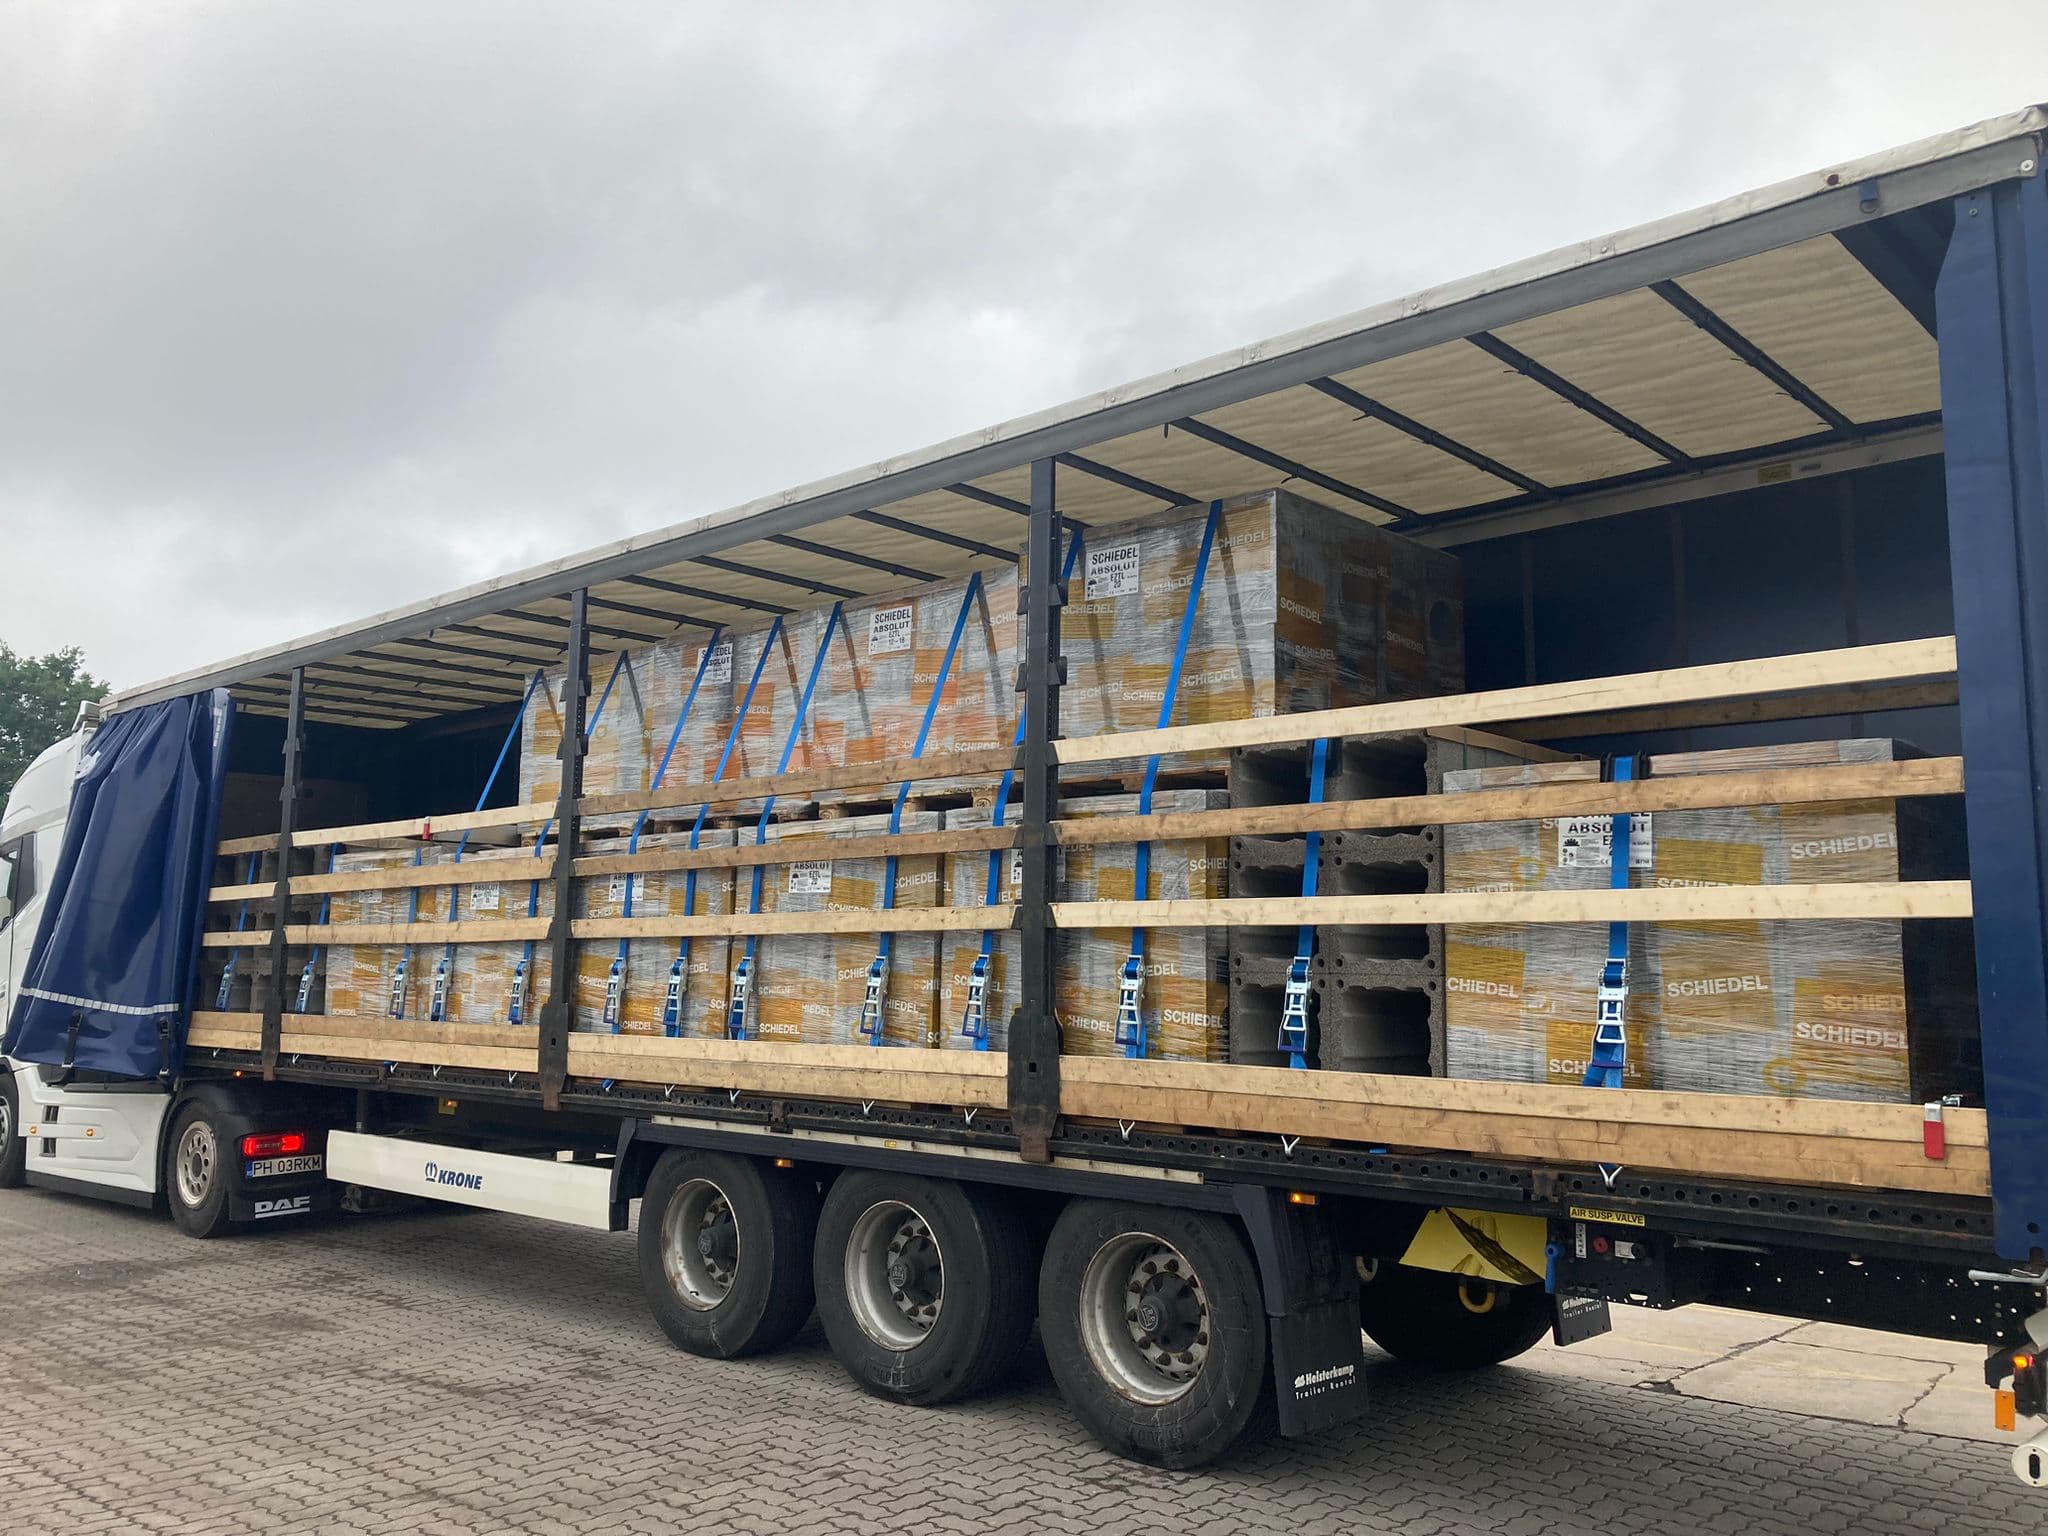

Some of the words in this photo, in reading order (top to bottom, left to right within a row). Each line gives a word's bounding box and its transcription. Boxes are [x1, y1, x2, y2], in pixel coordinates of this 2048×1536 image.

[1091, 547, 1138, 565] SCHIEDEL
[1090, 561, 1137, 576] ABSOLUT
[1144, 574, 1194, 598] SCHIEDE
[874, 608, 911, 624] SCHIEDEL
[1061, 603, 1115, 615] SCHIEDEL
[1280, 596, 1322, 624] SCHIEDEL
[873, 621, 910, 634] ABSOLUT
[1295, 645, 1336, 661] SCHIEDEL
[1182, 668, 1240, 687] SCHIEDEL
[1568, 821, 1646, 834] ABSOUT
[794, 861, 829, 870] ABSOLUT
[894, 871, 940, 888] SCHIEDEL
[353, 961, 380, 973] SCHIEDEL
[578, 975, 608, 988] SCHIEDE
[1447, 977, 1519, 998] CHIEDEL
[1667, 975, 1768, 997] SCHIEDEL
[1163, 1009, 1223, 1028] SCHIEDEL
[759, 1023, 800, 1034] SCHIEDEL
[1796, 1022, 1908, 1049] SCHIEDEL
[253, 1161, 272, 1175] PH
[438, 1169, 483, 1190] KRONE
[255, 1196, 310, 1213] DAF
[1571, 1208, 1586, 1216] AIR
[1588, 1209, 1615, 1220] SUSP.
[1615, 1214, 1644, 1224] VALVE
[1296, 1386, 1325, 1400] Trailer
[1330, 1375, 1356, 1389] Rental
